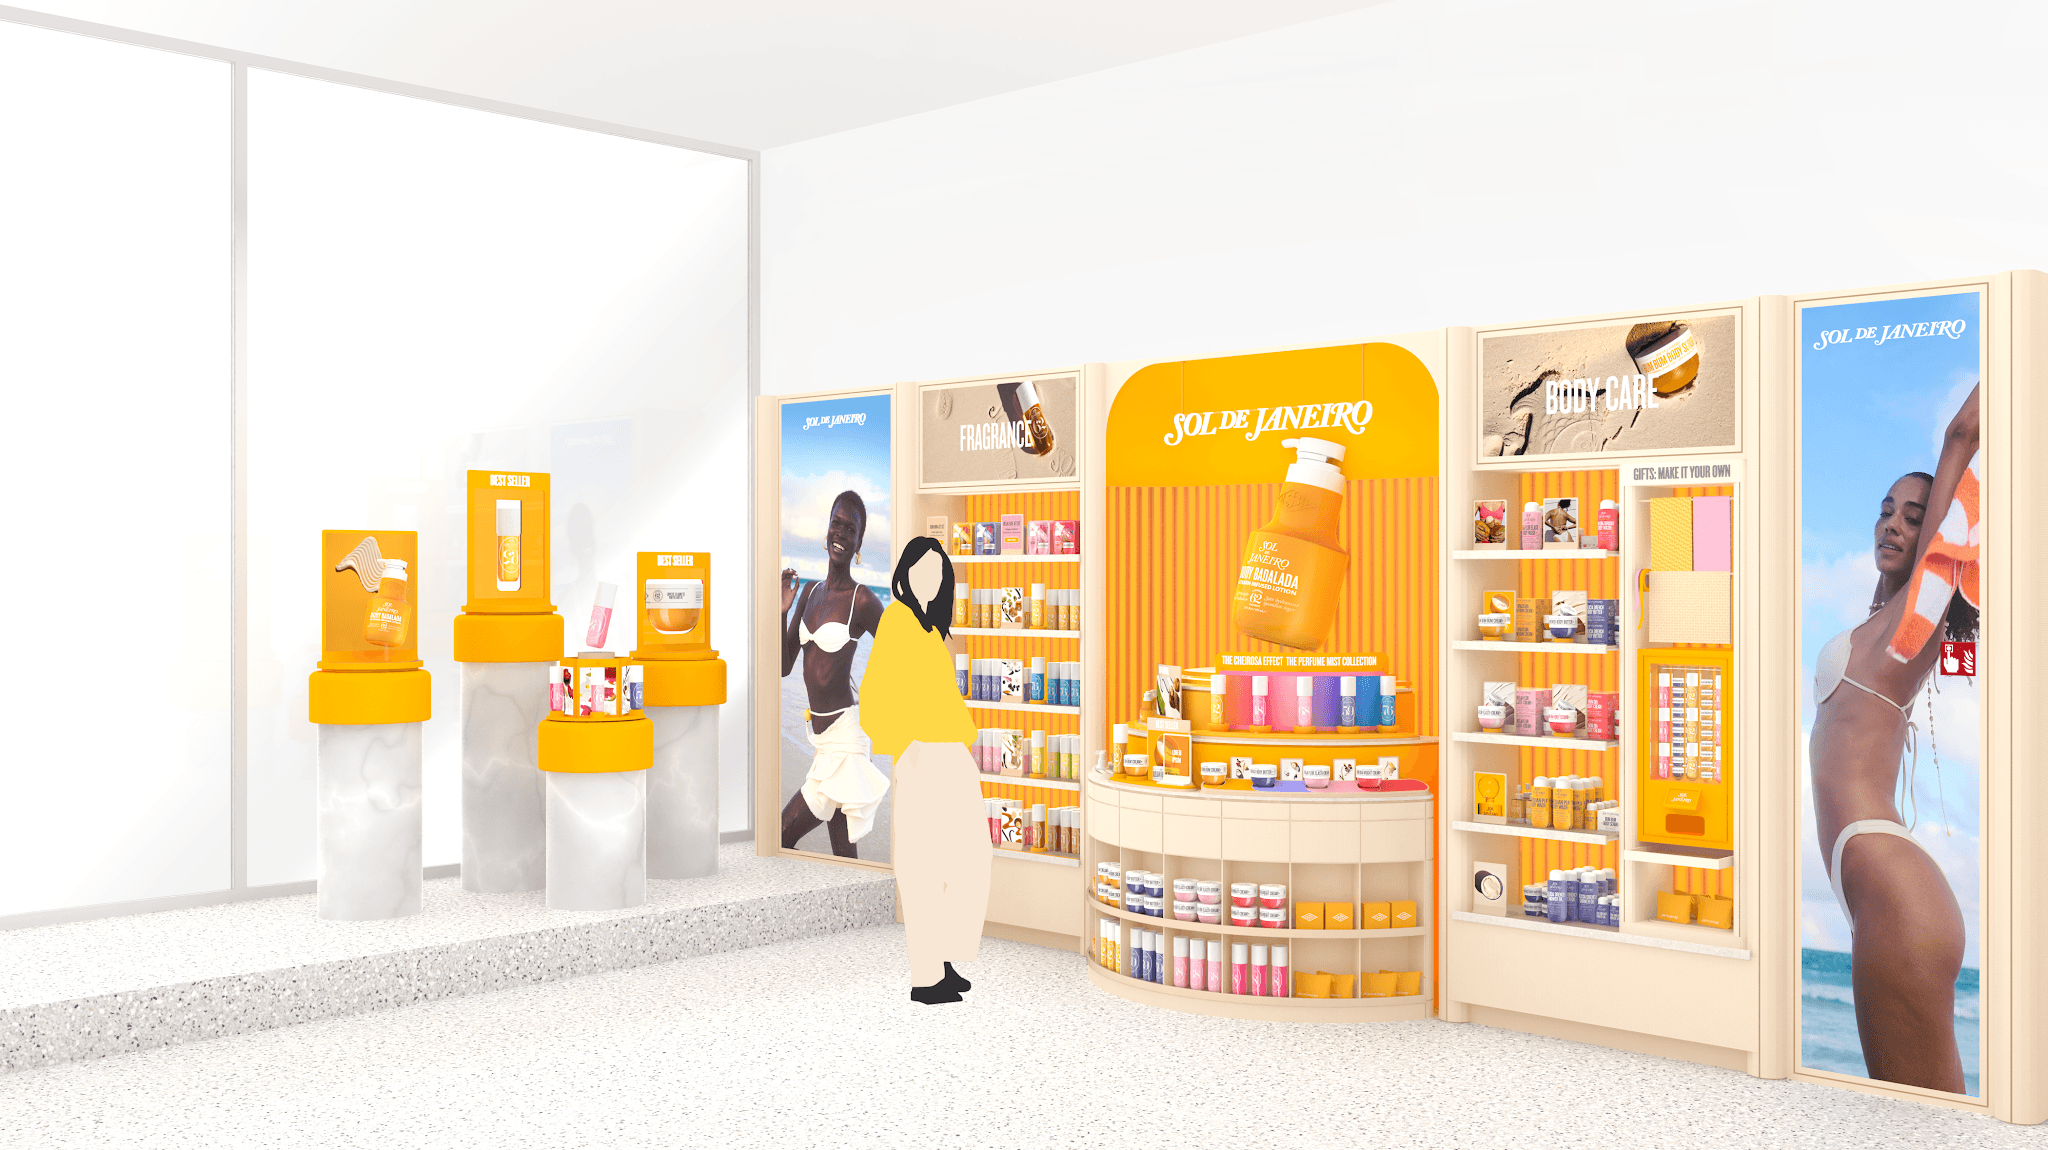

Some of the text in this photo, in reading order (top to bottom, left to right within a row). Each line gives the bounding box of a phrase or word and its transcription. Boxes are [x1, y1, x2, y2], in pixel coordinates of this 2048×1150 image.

[1813, 319, 1966, 350] SOL DE JANEIRO
[1653, 354, 1668, 370] BUM
[1667, 345, 1683, 362] BODY
[1546, 373, 1659, 415] BODY CARE
[803, 413, 866, 430] SOL DE JANEIRO
[1164, 400, 1373, 446] SOL DE JANEIRO
[960, 420, 1032, 451] FRAGRANCE
[490, 474, 530, 487] BEST SELLER
[1633, 464, 1731, 480] GIFTS: MAKE IT YOUR OWN
[1259, 541, 1278, 552] SOL
[657, 554, 694, 566] BEST SELLER
[1247, 553, 1289, 570] JANEIRO
[1253, 567, 1299, 590] BADALADA
[1250, 593, 1262, 604] 62
[1272, 586, 1297, 596] LOTION
[1222, 655, 1377, 666] THE CHEIROSA EFFECT THE PERFUME MIST COLLECTION
